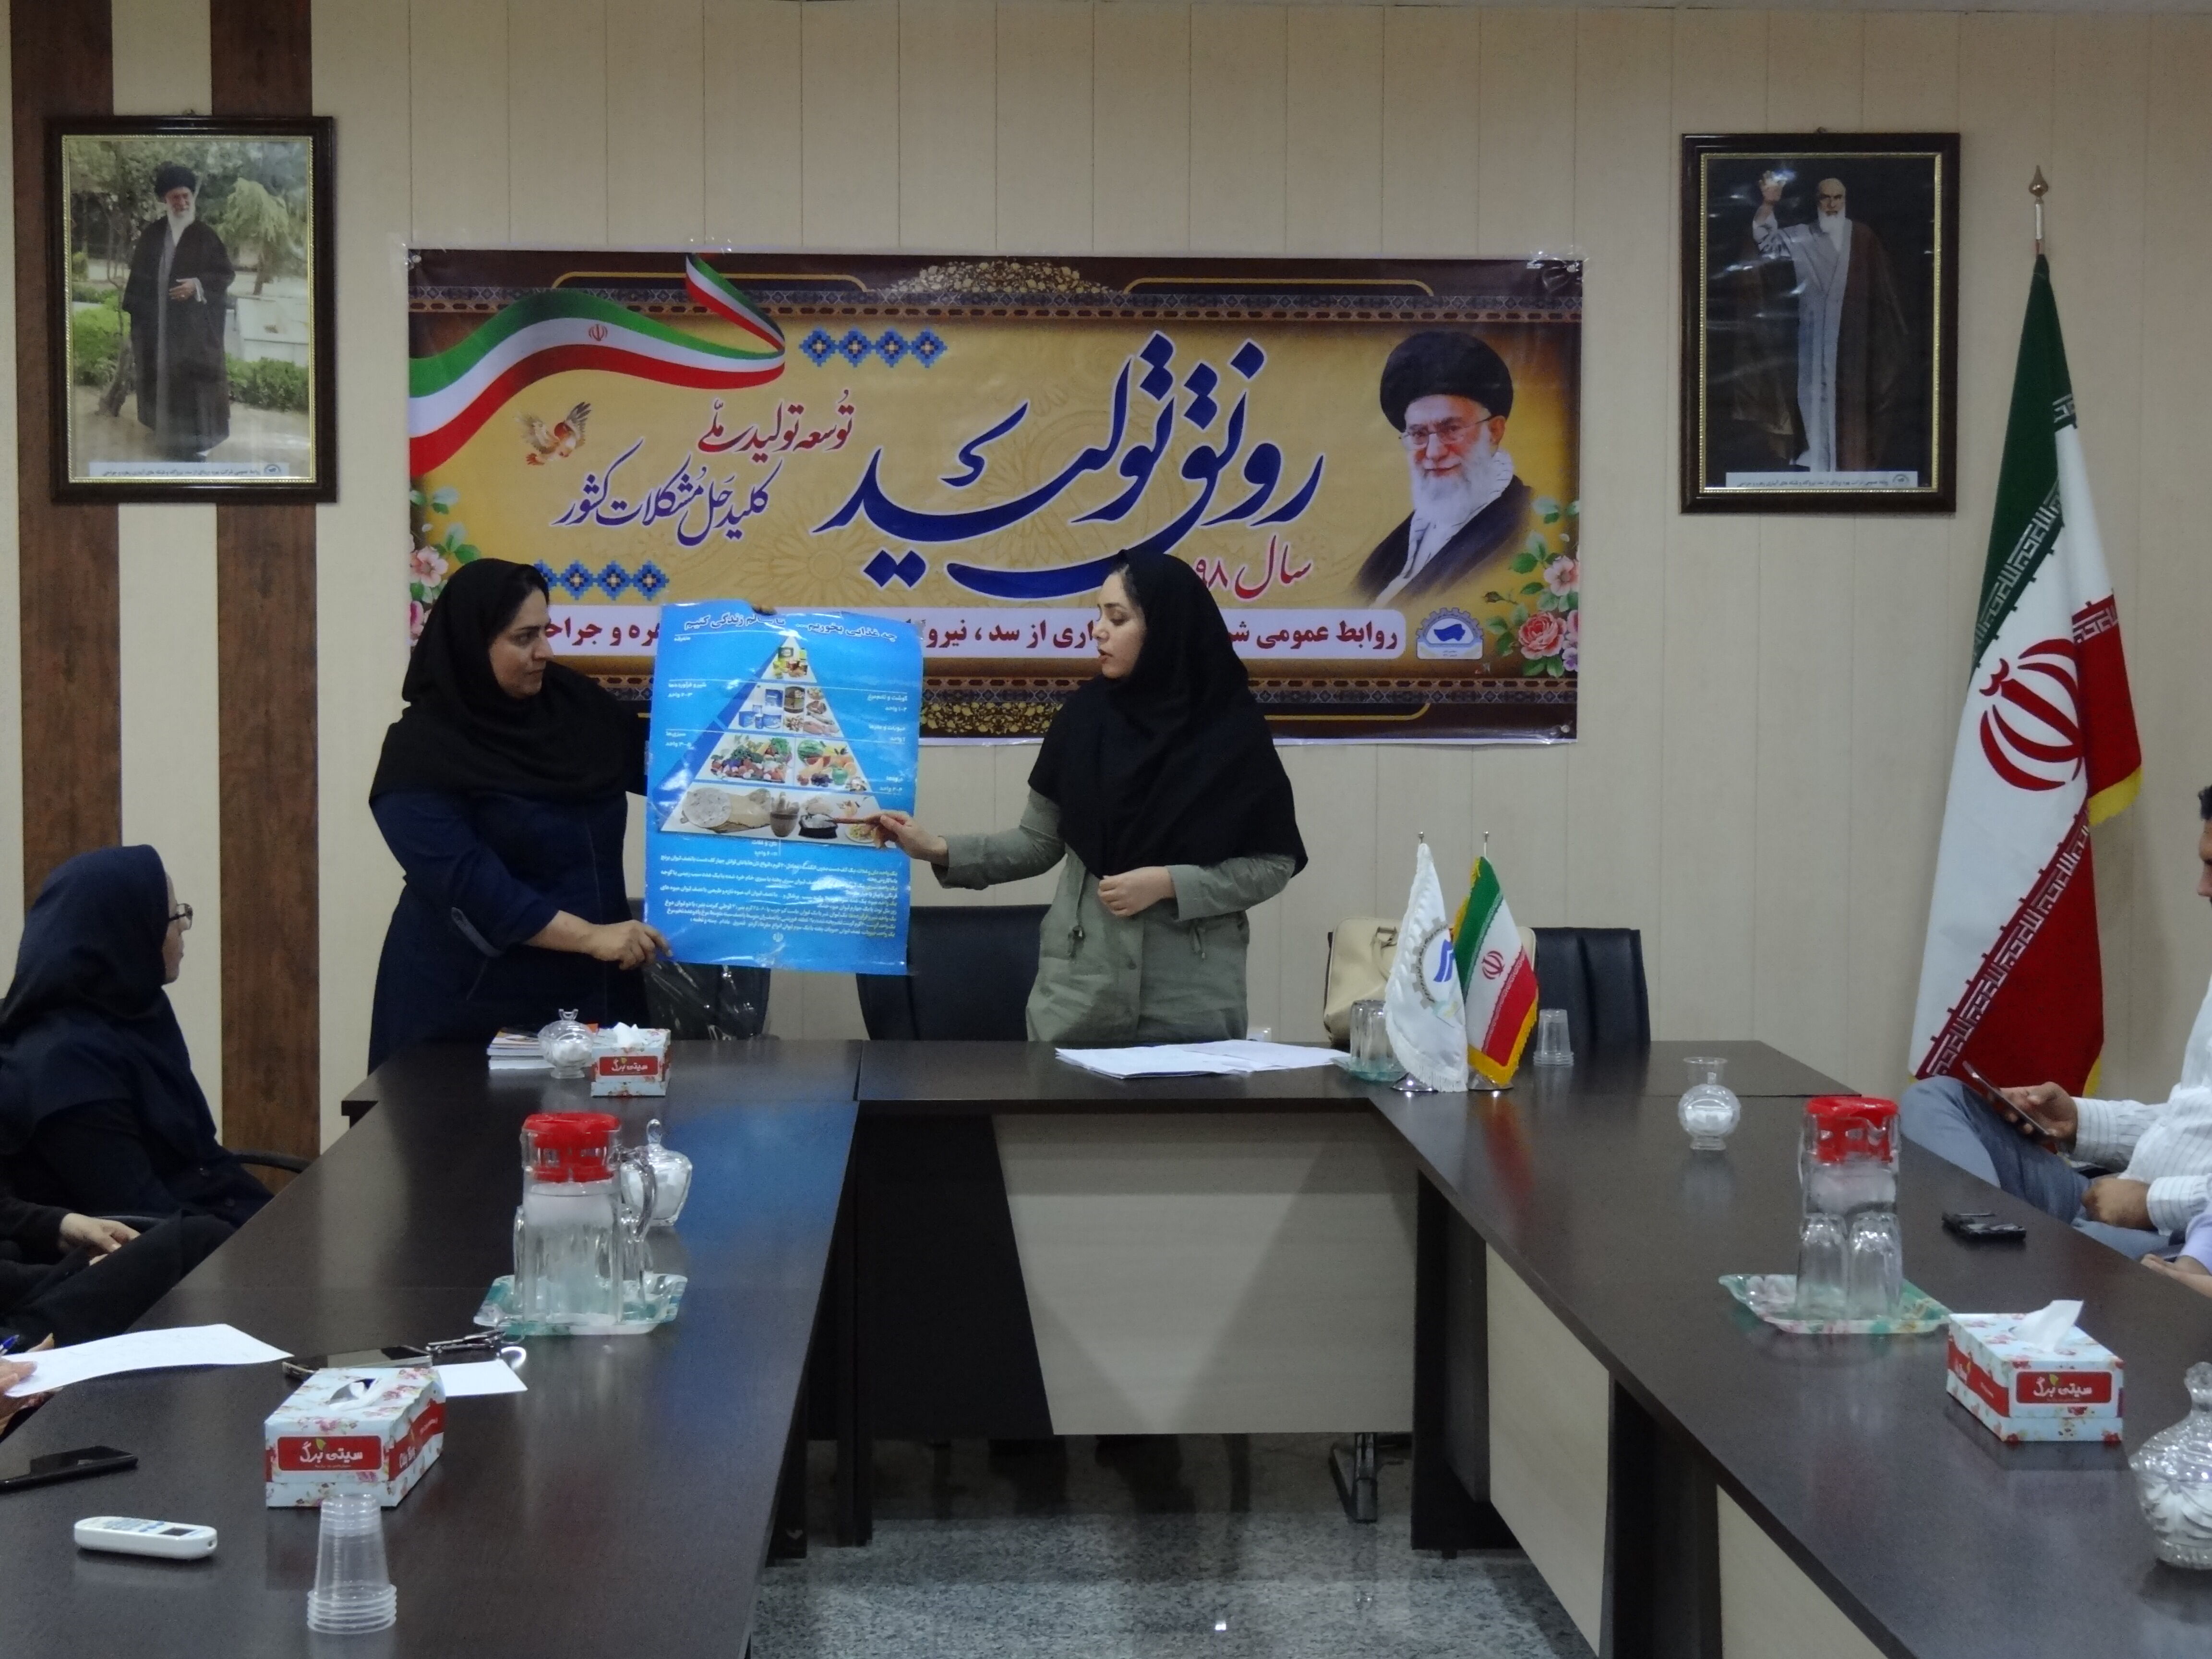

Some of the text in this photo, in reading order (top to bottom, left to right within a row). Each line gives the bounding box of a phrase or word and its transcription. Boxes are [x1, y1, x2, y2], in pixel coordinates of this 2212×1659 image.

[738, 402, 805, 463] تولید
[812, 332, 1323, 599] رونق تولید
[552, 438, 644, 525] کشور
[713, 458, 783, 540] کلید
[1234, 534, 1312, 599] سال
[684, 615, 711, 630] کنیم
[710, 612, 744, 628] زندگی
[845, 626, 880, 637] غذایی
[610, 627, 622, 646] و
[1026, 619, 1046, 649] از
[1256, 625, 1329, 649] عمومی
[1336, 620, 1398, 649] روابط
[2033, 1376, 2093, 1398] سیتی برگ
[299, 1441, 363, 1464] سیتی برگ
